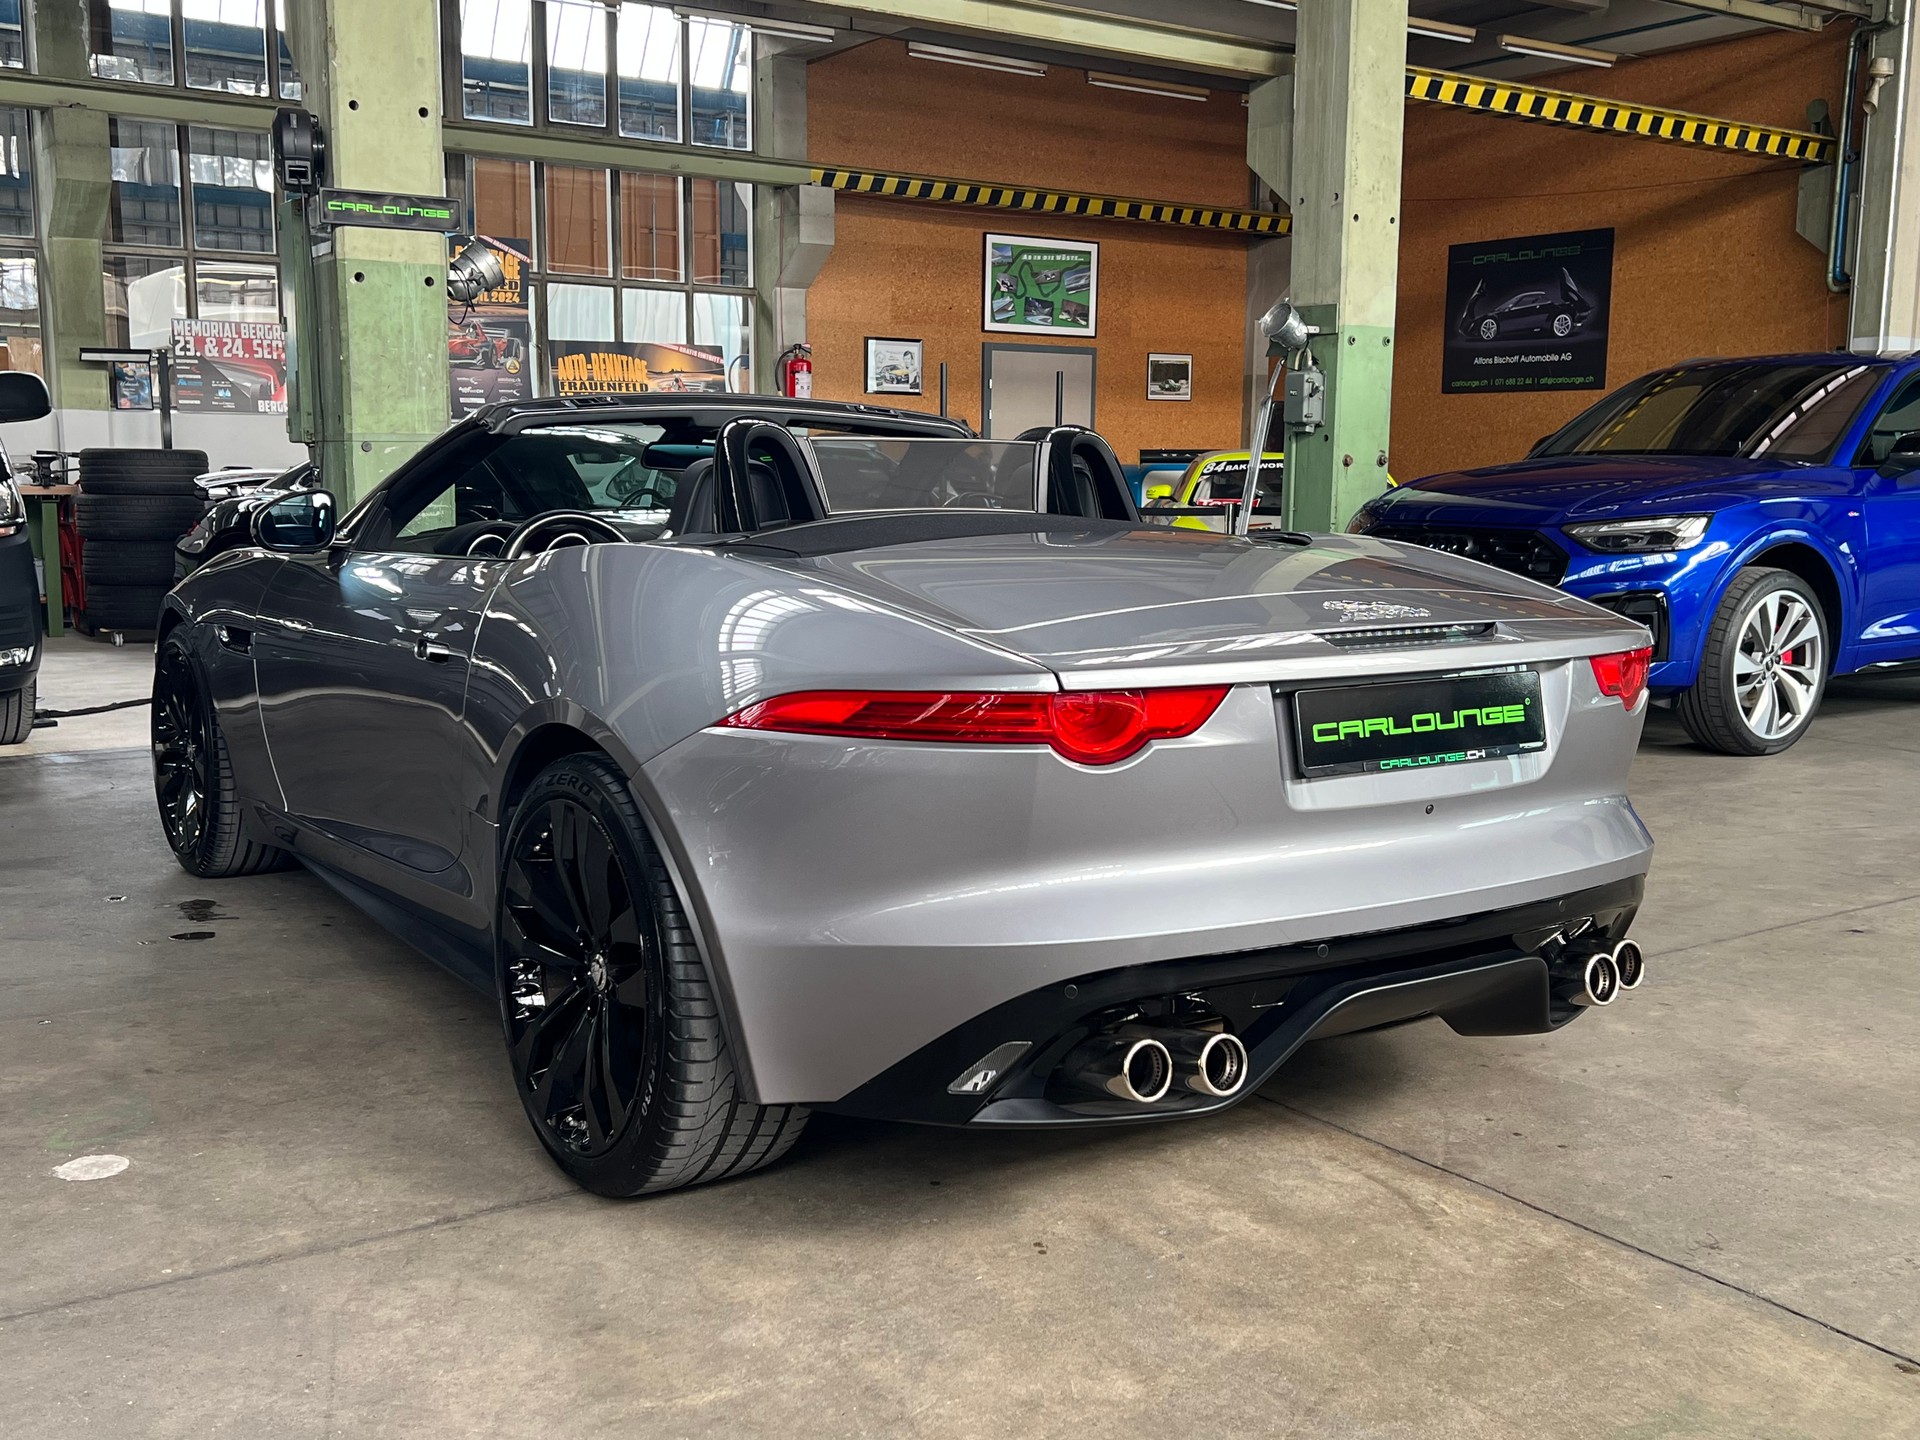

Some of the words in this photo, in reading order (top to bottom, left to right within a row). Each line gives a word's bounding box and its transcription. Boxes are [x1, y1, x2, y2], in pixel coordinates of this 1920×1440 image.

[327, 200, 450, 219] CARLOUNGE
[1472, 245, 1581, 265] CARLOUNGE
[491, 291, 520, 303] 2024
[173, 320, 238, 338] MEMORIAL
[240, 323, 285, 341] BERGR
[174, 336, 201, 357] 23.
[204, 337, 219, 357] &
[222, 338, 250, 359] 24.
[558, 352, 649, 382] AUTO-RENNTAGE
[1494, 354, 1519, 364] Bischoff
[1520, 352, 1559, 363] Automobile
[1560, 352, 1573, 361] AG
[560, 381, 649, 392] FRAUENFELD
[1451, 379, 1488, 388] carlounge.ch
[1517, 377, 1524, 385] 22
[1202, 461, 1227, 474] 84
[1380, 749, 1486, 770] CARLOUNGE.CH
[545, 773, 594, 797] ZERO
